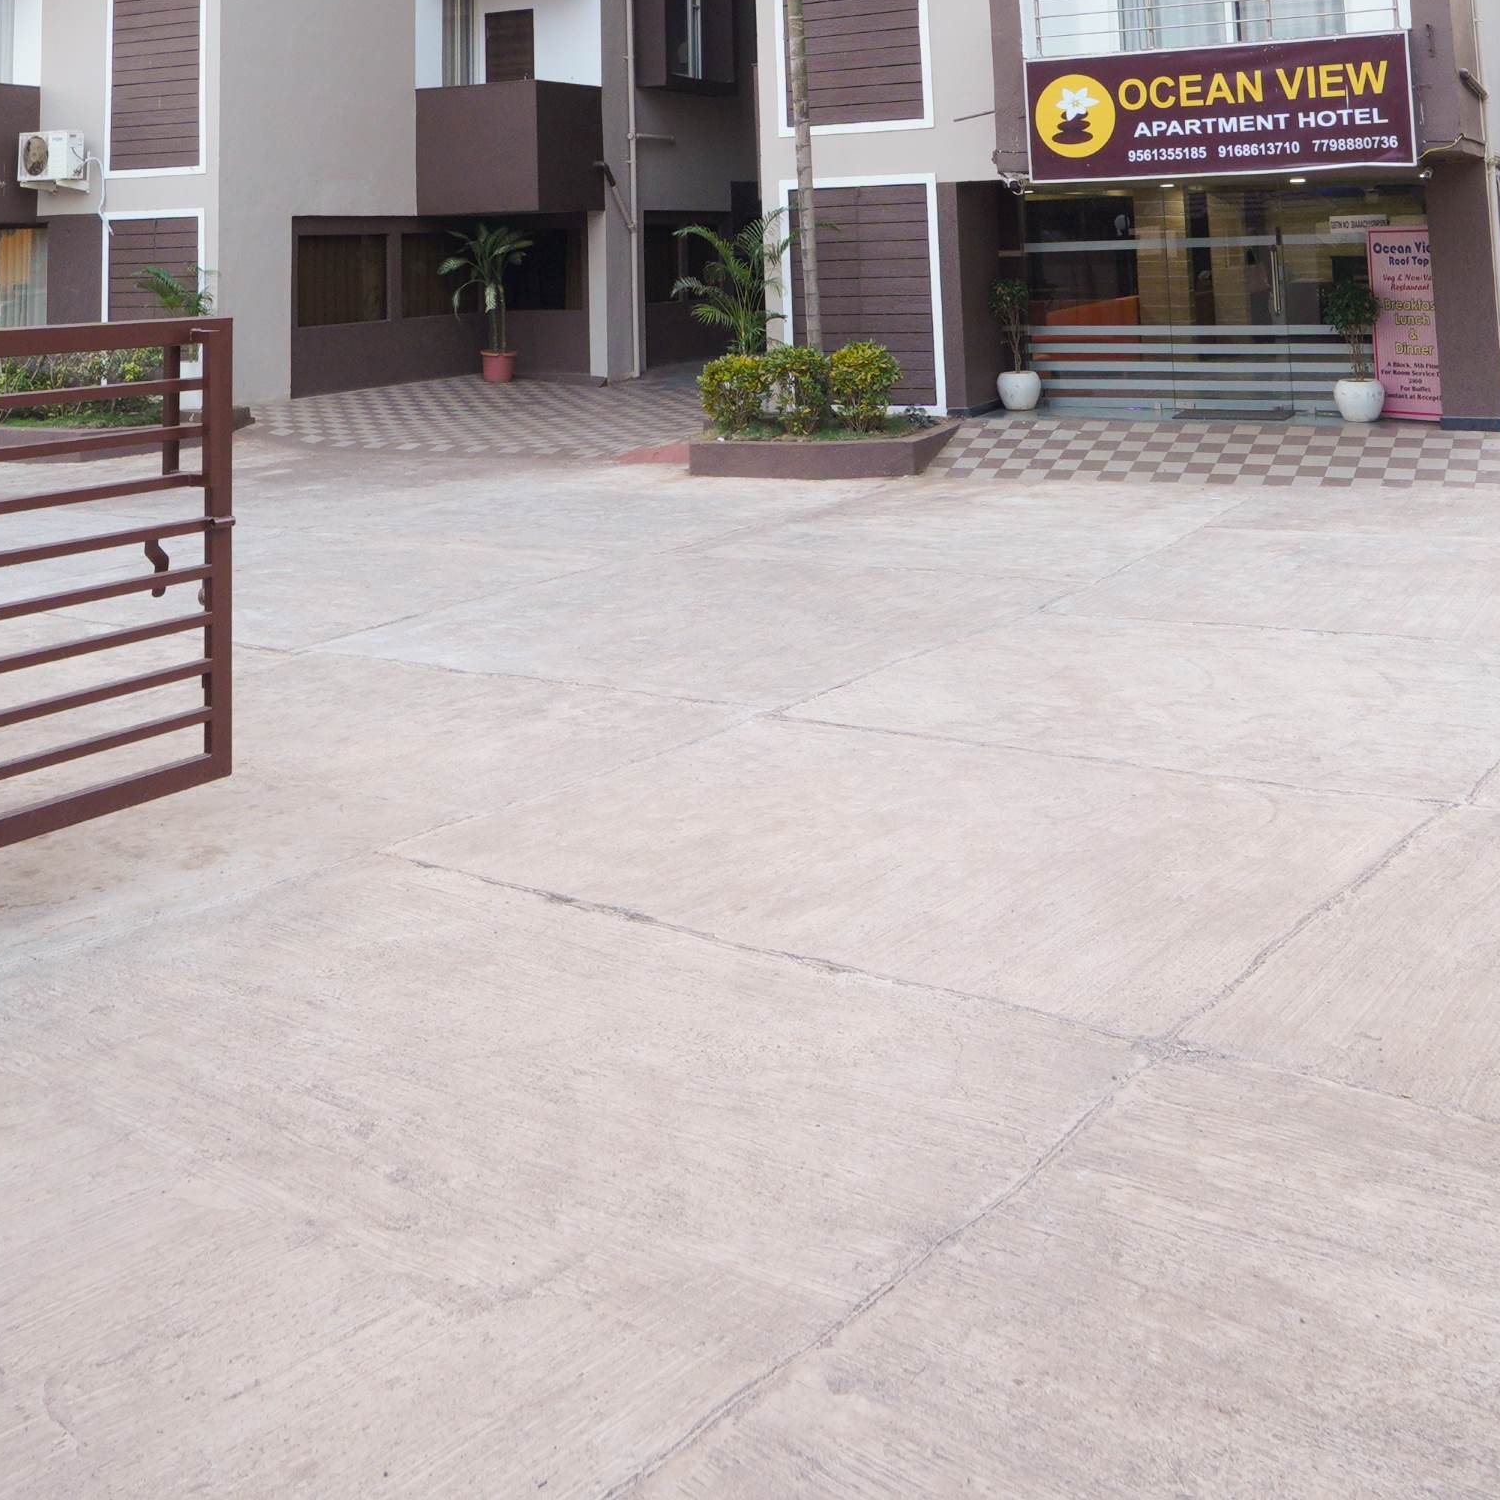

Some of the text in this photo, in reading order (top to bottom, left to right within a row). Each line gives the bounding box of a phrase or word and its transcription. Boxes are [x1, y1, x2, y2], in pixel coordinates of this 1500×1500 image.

[1118, 60, 1388, 111] OCEAN VIEW
[1133, 108, 1389, 138] APARTMENT HOTEL
[1128, 135, 1399, 162] 9561355185 9168613710 7798880736
[1373, 241, 1431, 254] Ocean Vie
[1389, 256, 1429, 267] Roof Top
[1384, 299, 1435, 311] Breakfas
[1395, 316, 1430, 325] Lunch
[1409, 328, 1418, 340] &
[1395, 342, 1433, 356] Dinner
